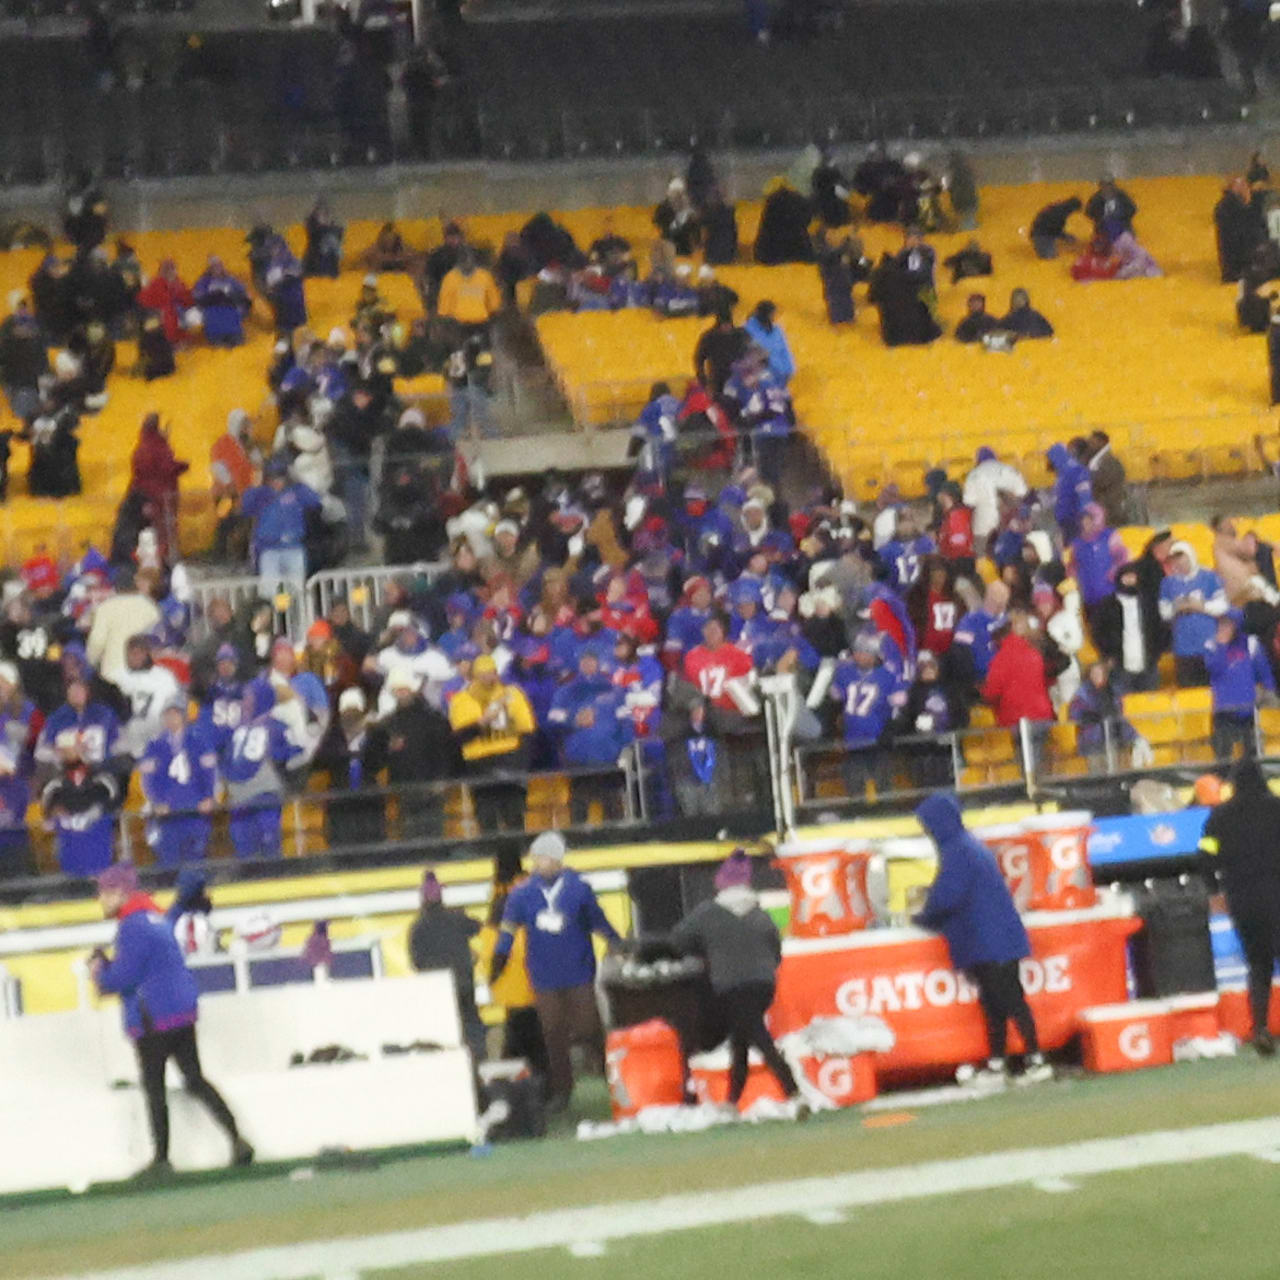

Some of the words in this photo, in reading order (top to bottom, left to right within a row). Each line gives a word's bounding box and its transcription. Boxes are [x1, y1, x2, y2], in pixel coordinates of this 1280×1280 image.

[698, 665, 726, 698] 17
[845, 683, 878, 715] 17
[1002, 844, 1029, 878] G
[1052, 836, 1079, 870] G
[802, 864, 832, 896] G
[835, 955, 1072, 1015] GATODE
[1118, 1023, 1152, 1061] G
[817, 1058, 853, 1097] G
